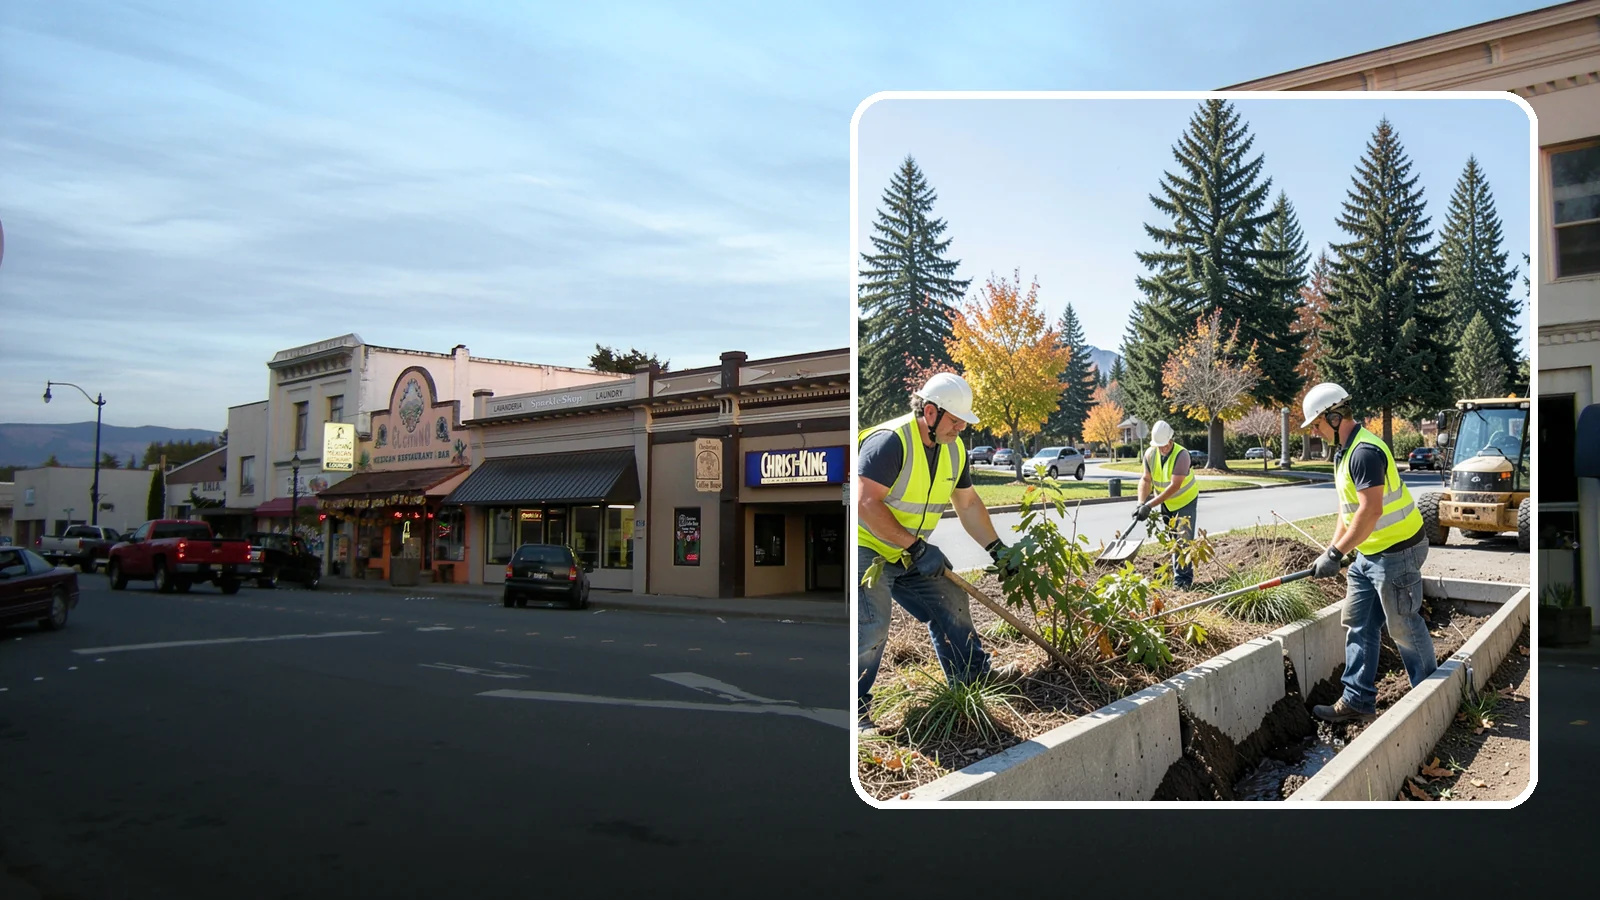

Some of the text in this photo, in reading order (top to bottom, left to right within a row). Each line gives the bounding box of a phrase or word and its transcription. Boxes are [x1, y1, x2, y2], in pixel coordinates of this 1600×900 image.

[595, 389, 623, 400] LAUNDRY
[493, 402, 523, 413] LAVANDERIA
[373, 450, 450, 464] MEXICAN RESTAURANT BAR
[761, 449, 827, 478] CHRIST KING
